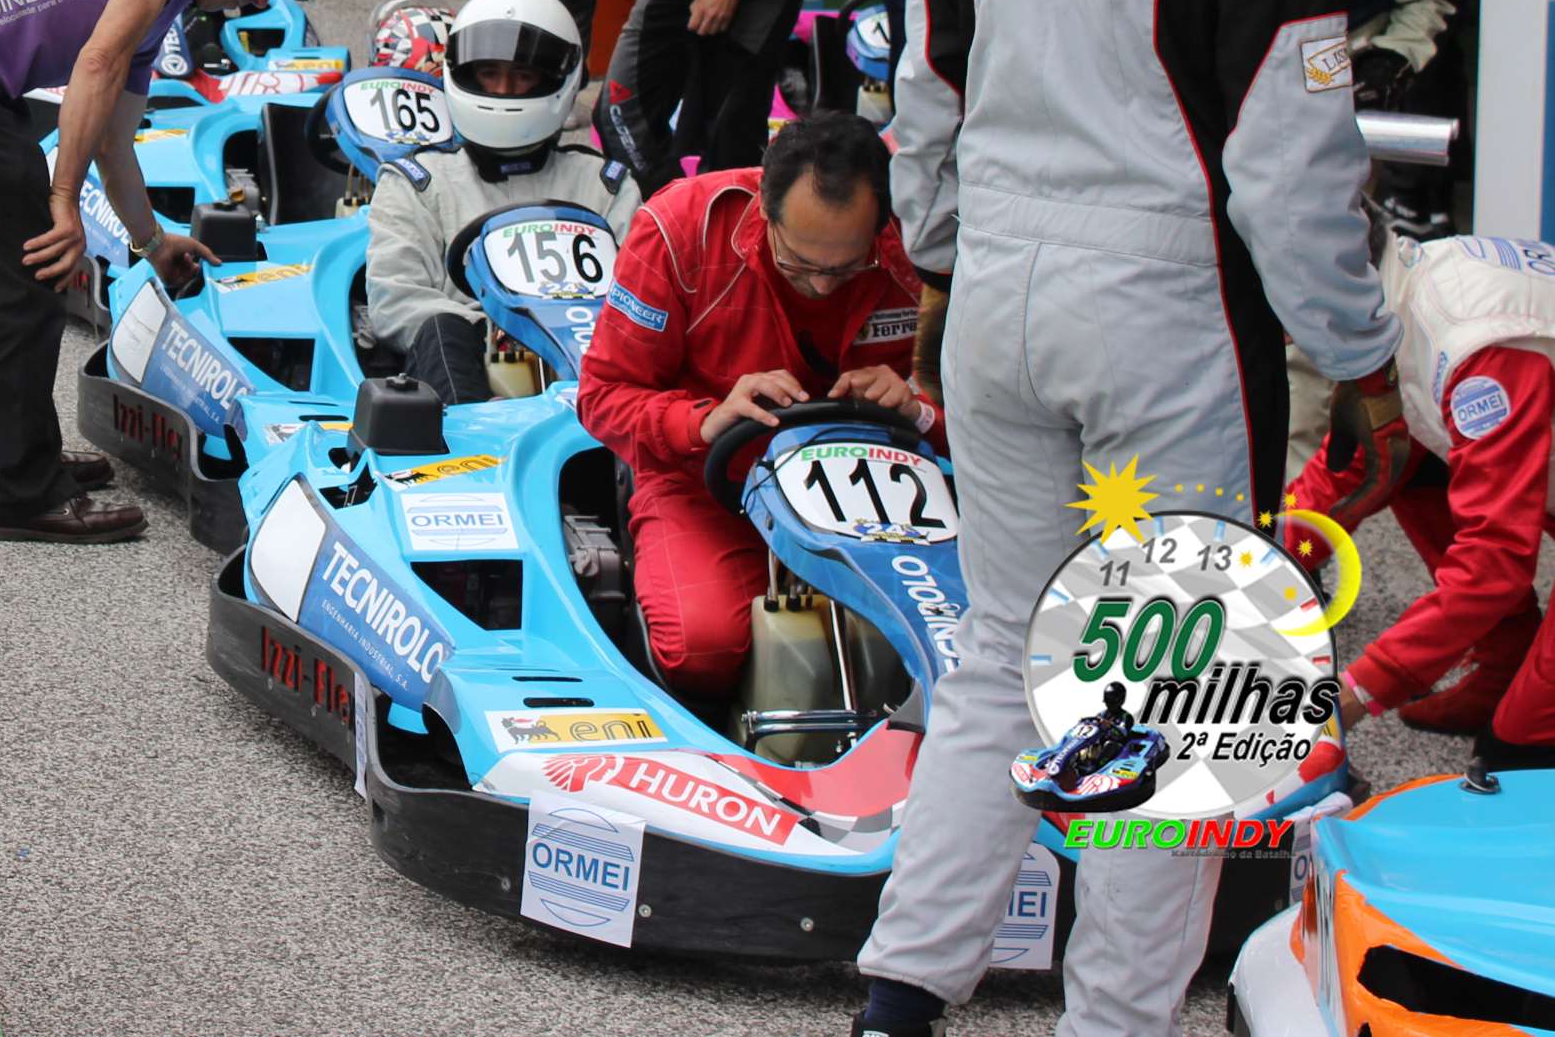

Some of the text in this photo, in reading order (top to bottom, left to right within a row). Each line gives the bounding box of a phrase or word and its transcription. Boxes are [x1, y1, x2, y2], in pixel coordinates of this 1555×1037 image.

[359, 80, 437, 94] EUROINDY
[369, 87, 440, 134] 165
[502, 223, 598, 239] EUROINDY
[506, 232, 604, 285] 156
[611, 286, 664, 324] PIONEER
[1457, 394, 1504, 423] ORMEI
[436, 454, 502, 477] eni
[801, 446, 924, 467] EUROINDY
[804, 458, 947, 529] 112
[410, 513, 505, 528] ORMEI
[568, 711, 656, 742] eni
[628, 763, 782, 838] HURON
[531, 841, 631, 893] ORMEI
